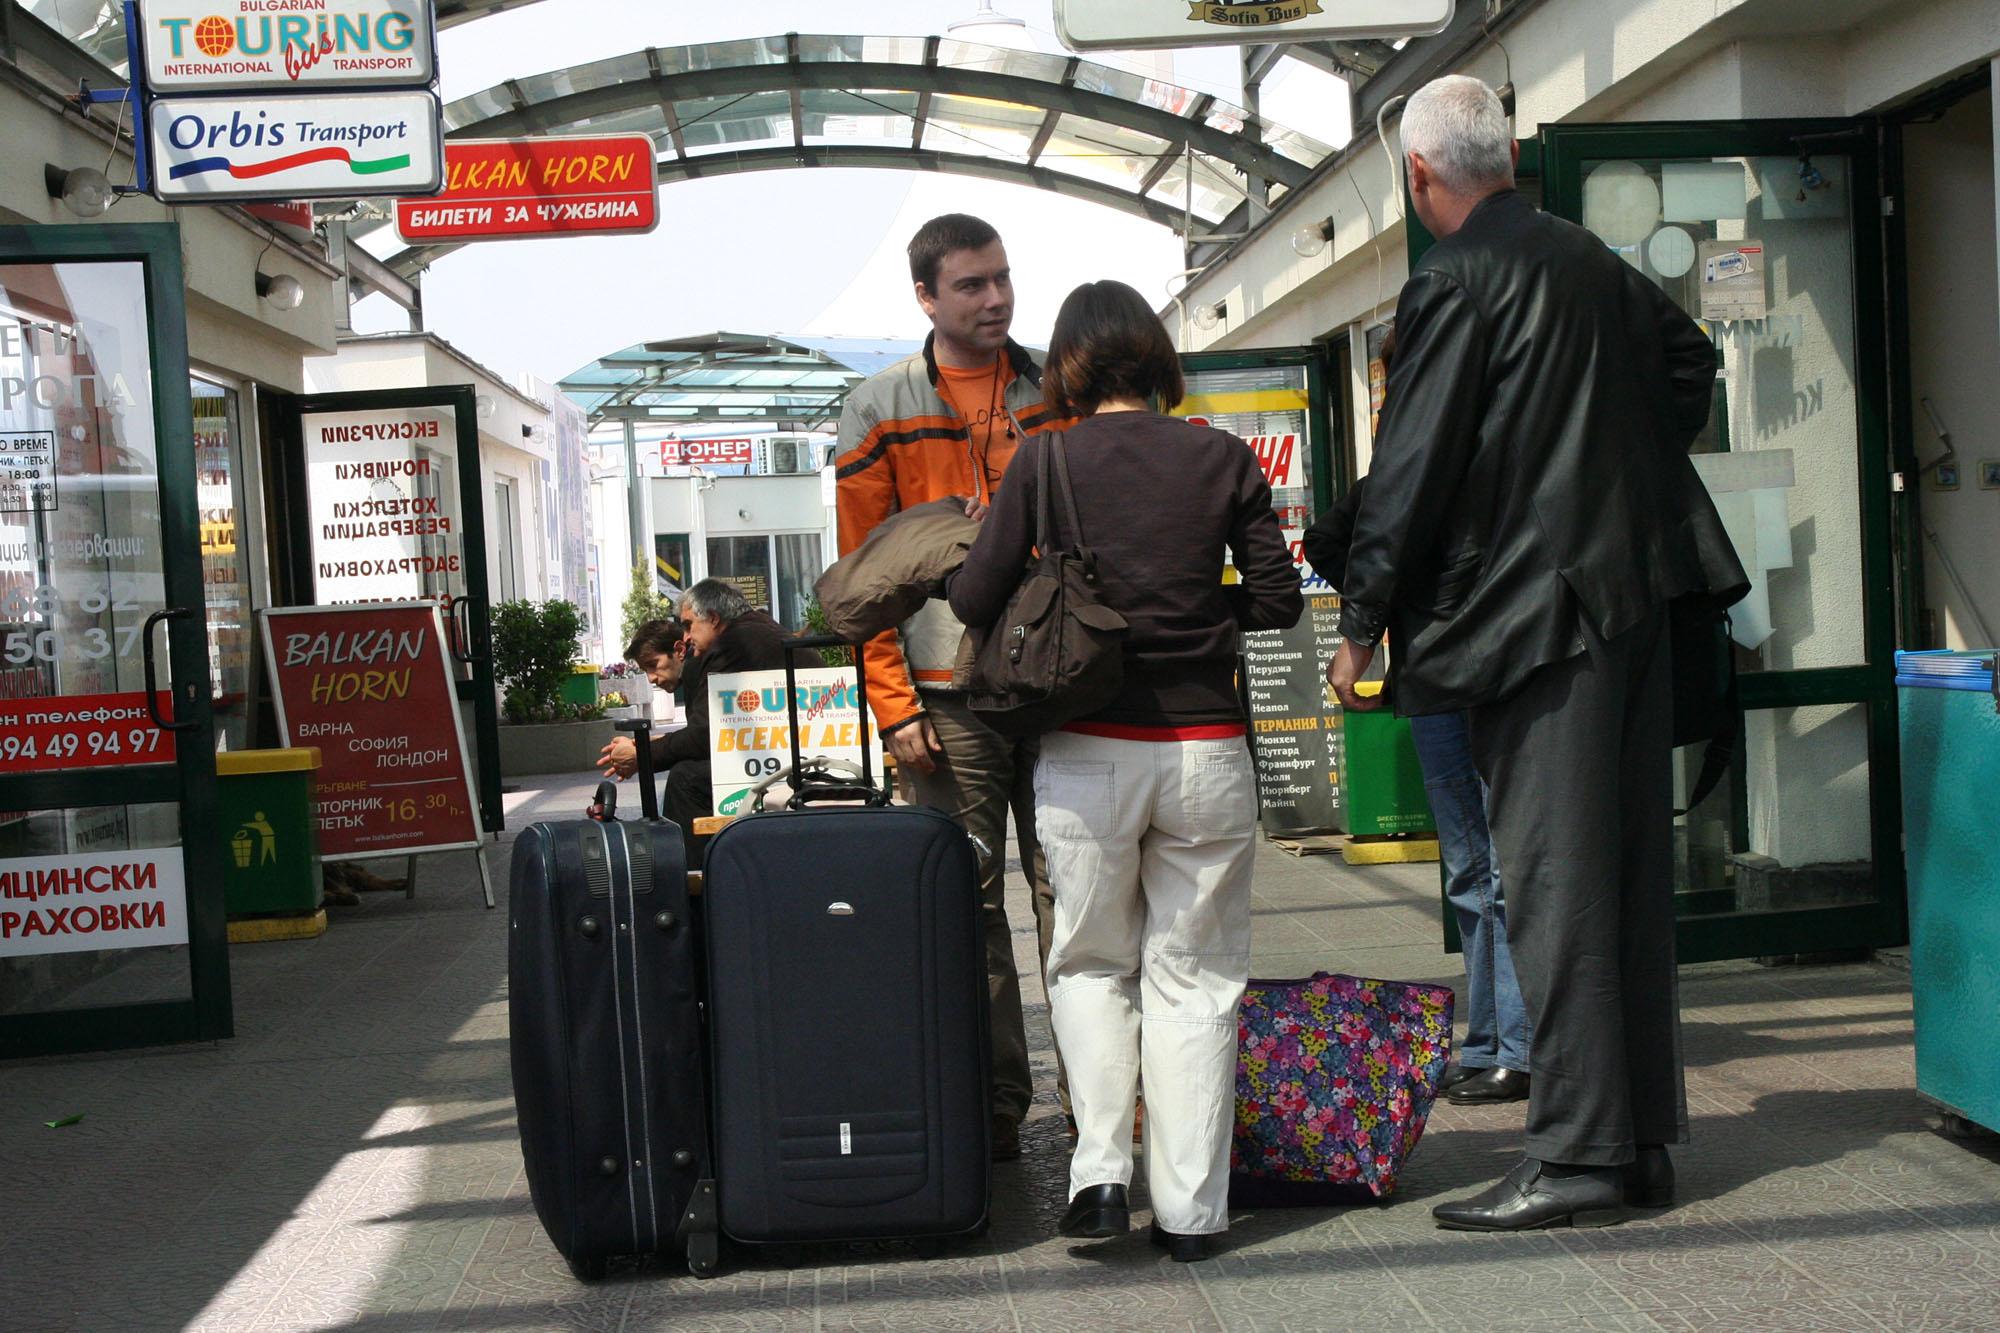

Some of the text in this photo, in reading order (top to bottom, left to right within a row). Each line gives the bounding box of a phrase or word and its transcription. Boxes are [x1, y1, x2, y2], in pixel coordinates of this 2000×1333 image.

[240, 0, 325, 12] BULGARIAN
[1210, 6, 1300, 24] Sofia Bus
[285, 31, 335, 80] bus
[164, 58, 413, 76] INTERNATIONAL TRANSPORT
[169, 110, 407, 150] Orbis Transport
[446, 153, 634, 191] LKAN HORN
[410, 200, 639, 227] БИЛЕТИ ЗА ЧУЖБИНА
[13, 438, 48, 451] ВРЕМЕ
[663, 441, 750, 459] ДЮНЕР
[8, 469, 40, 480] 18:00
[1312, 612, 1341, 622] Барсе
[4, 626, 140, 664] 50 37
[284, 628, 425, 666] BALKAN
[1246, 640, 1284, 648] Милано
[1247, 651, 1302, 662] Флоренция
[1248, 665, 1291, 675] Перуджа
[311, 667, 412, 705] HORN
[1250, 678, 1286, 687] Анкона
[807, 676, 847, 721] agency
[1251, 691, 1270, 700] Рим
[1253, 703, 1289, 713] Неапол
[26, 707, 147, 725] телефон:
[299, 722, 354, 737] ВАРНА
[1254, 717, 1318, 732] ГЕРМАНИЯ
[45, 733, 79, 758] 49
[87, 730, 121, 755] 94
[129, 728, 160, 753] 97
[349, 736, 408, 752] СОФИЯ
[1256, 736, 1296, 744] Мюнхен
[376, 749, 448, 768] ЛОНДОН
[1259, 758, 1316, 771] Франкфурт
[1260, 773, 1291, 782] Кьолн
[1261, 785, 1311, 797] Нюрнберг
[1263, 799, 1295, 809] Майнц
[0, 901, 166, 939] РАХОВКИ
